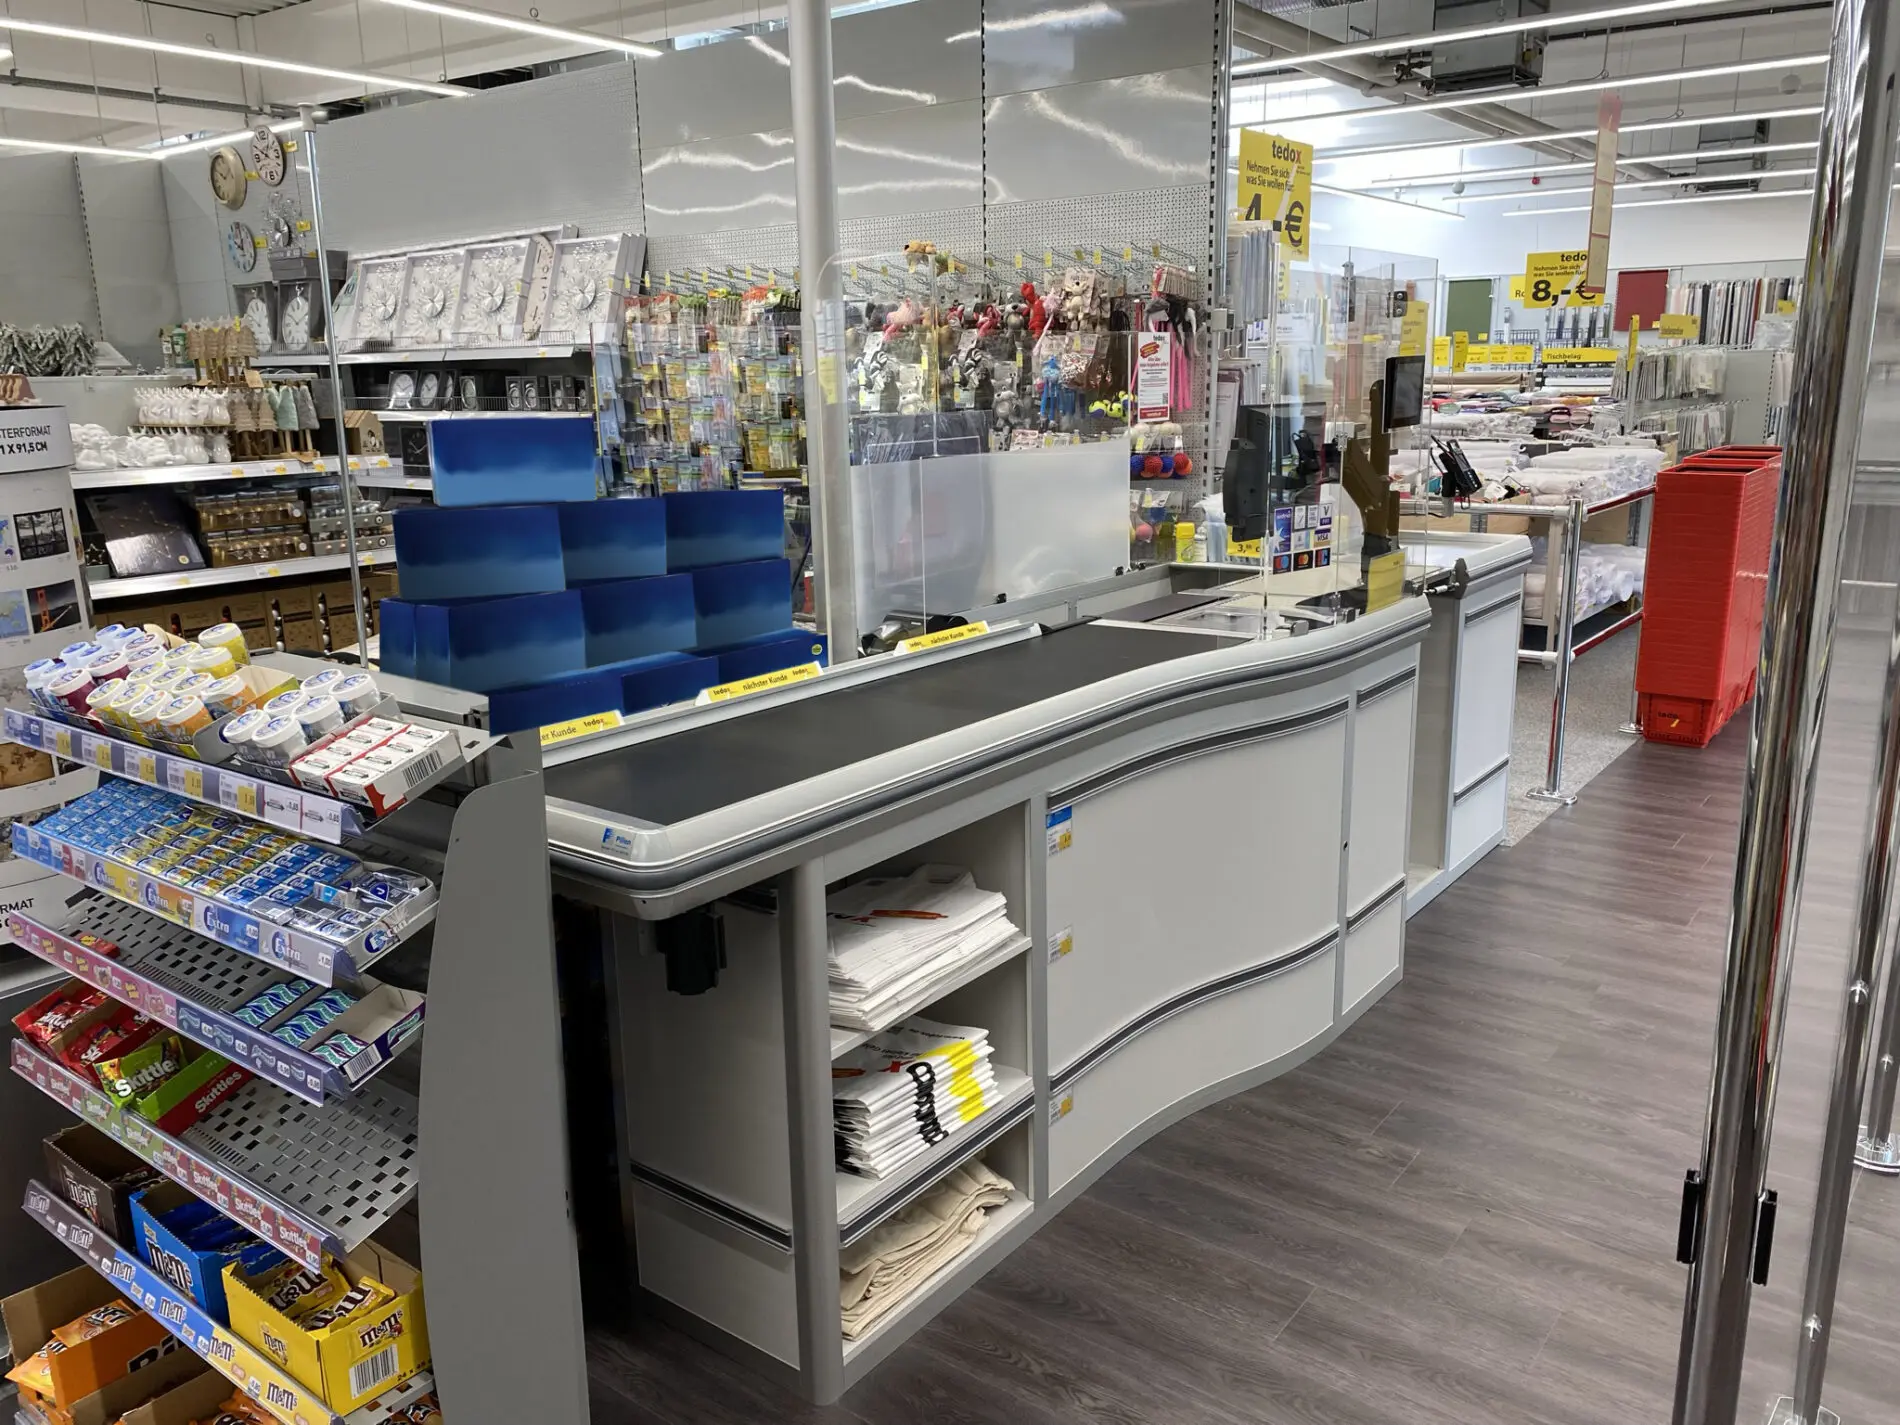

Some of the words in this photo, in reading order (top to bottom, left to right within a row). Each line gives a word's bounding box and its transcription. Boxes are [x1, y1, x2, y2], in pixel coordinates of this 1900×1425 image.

[260, 131, 267, 140] 12
[254, 153, 261, 162] 9
[274, 149, 280, 158] 3
[1272, 140, 1302, 164] tedox
[269, 171, 275, 180] 6
[1246, 160, 1270, 175] Nehmen
[1271, 165, 1279, 177] Sie
[1279, 167, 1290, 179] sich
[1246, 175, 1257, 185] was
[1258, 176, 1267, 187] Sie
[1267, 178, 1284, 190] wollen
[1285, 200, 1304, 247] €
[1532, 279, 1571, 306] 8,-
[0, 425, 51, 439] TERFORMAT
[1317, 533, 1329, 542] VISA
[713, 688, 731, 696] tedox
[743, 680, 768, 691] nächster
[768, 675, 788, 684] Kunde
[792, 668, 808, 676] tedox
[551, 726, 577, 738] Kunde
[583, 718, 604, 727] tedox
[206, 911, 230, 934] Extra
[194, 1071, 243, 1113] Skittles
[279, 1226, 308, 1251] Skittles
